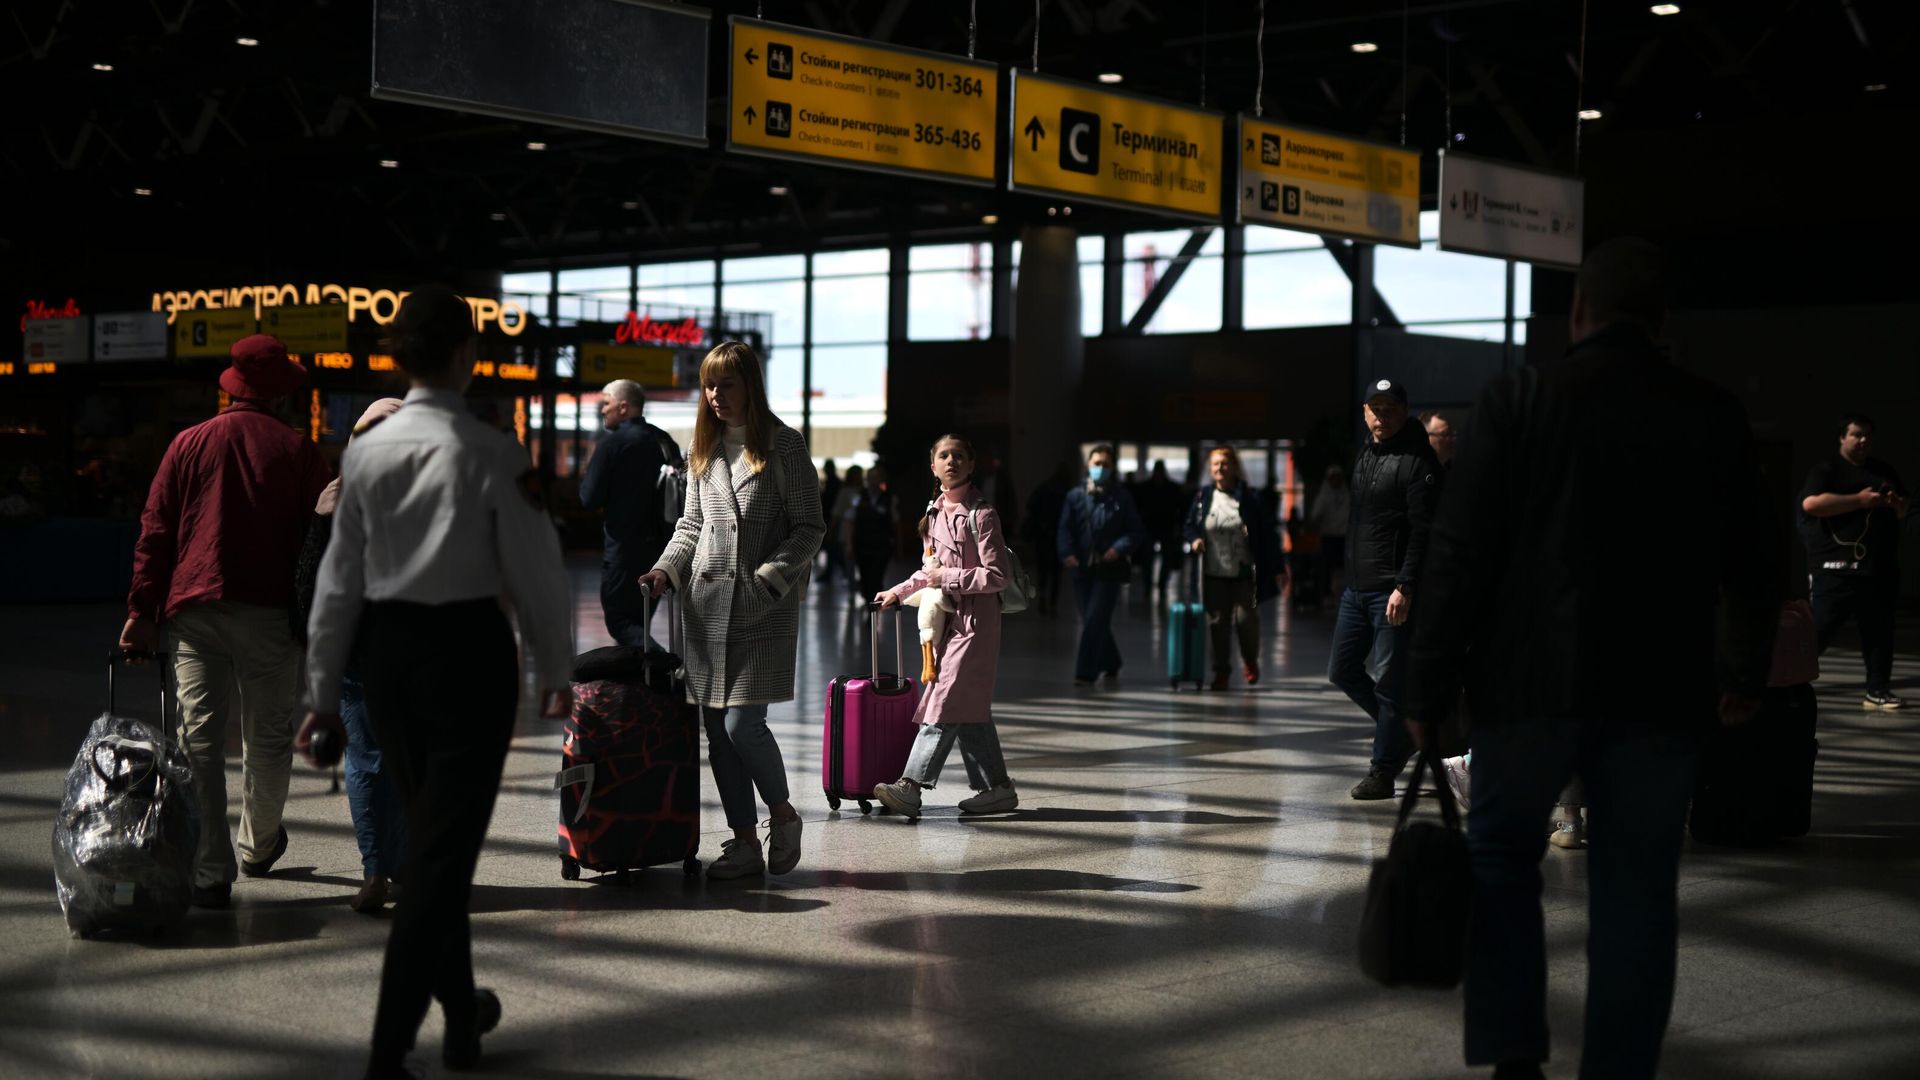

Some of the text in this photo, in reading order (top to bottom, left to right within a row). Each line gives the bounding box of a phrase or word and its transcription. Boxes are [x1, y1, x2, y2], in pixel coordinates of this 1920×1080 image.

[801, 52, 840, 70] Стойки
[843, 58, 911, 82] регистрации
[915, 68, 983, 97] 301-364
[799, 109, 839, 126] Стойки
[841, 114, 910, 138] регистрации
[914, 123, 982, 151] 365-436
[1112, 123, 1198, 159] Терминал
[1112, 163, 1163, 187] Terminal
